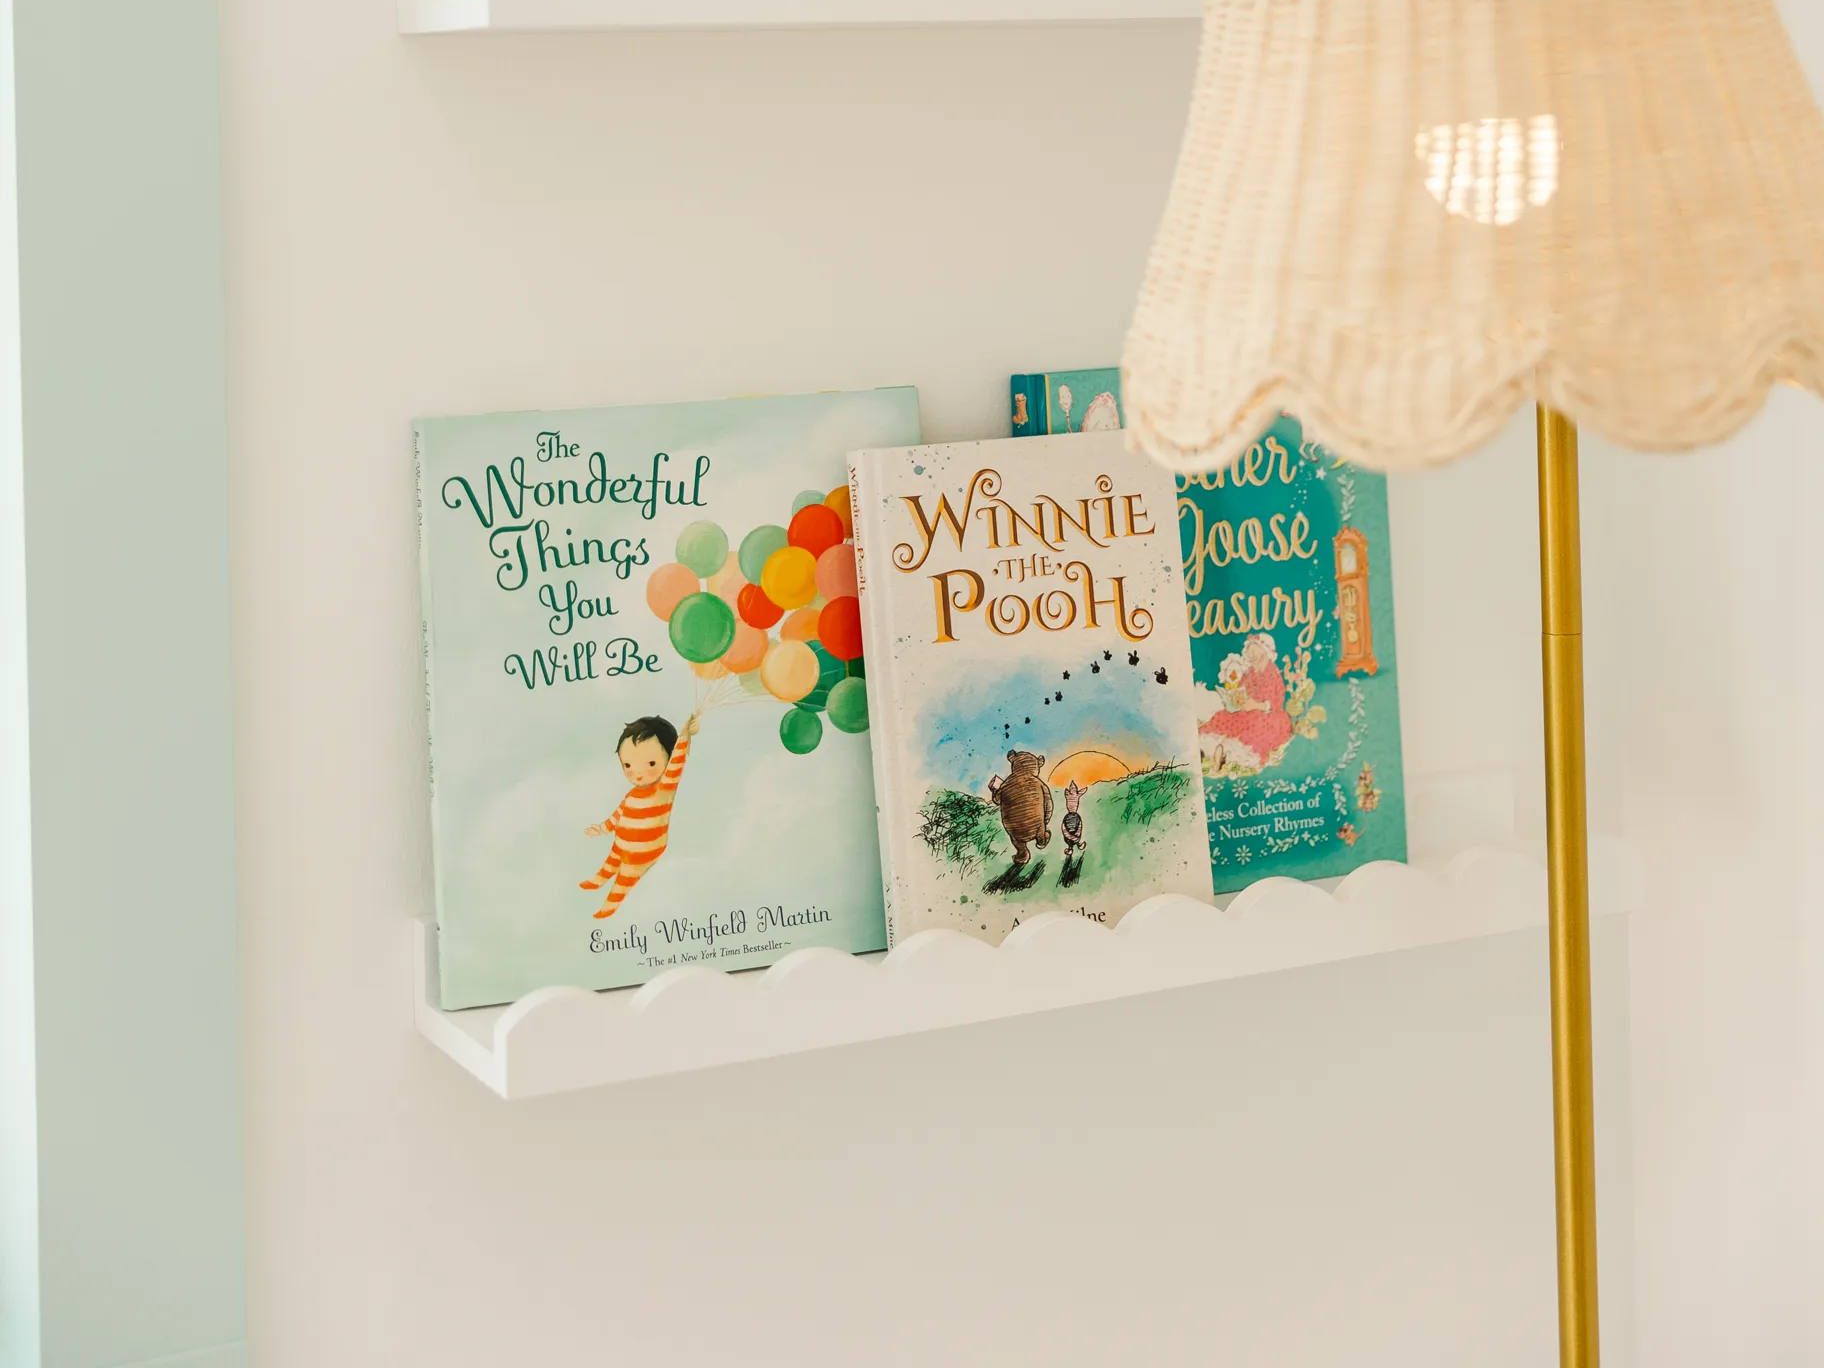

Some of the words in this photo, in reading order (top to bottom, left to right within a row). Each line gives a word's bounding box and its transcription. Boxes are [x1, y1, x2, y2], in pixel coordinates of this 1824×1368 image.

[536, 430, 581, 463] The
[441, 451, 711, 529] Wonderful
[489, 518, 650, 592] Things
[996, 552, 1056, 583] THE
[538, 579, 620, 636] You
[926, 560, 1155, 643] POOH
[1187, 586, 1324, 648] easury
[504, 640, 600, 690] Will
[605, 637, 664, 677] Be
[1206, 806, 1235, 823] eless
[1237, 797, 1305, 818] Collection
[1306, 791, 1323, 808] of
[1219, 823, 1271, 840] Nursery
[1273, 815, 1325, 838] Rhymes
[589, 923, 648, 955] Emily
[654, 909, 748, 945] Winfield
[756, 905, 833, 933] Martin
[646, 956, 665, 968] The
[667, 953, 677, 964] #1
[680, 951, 698, 963] New
[700, 947, 717, 959] York
[720, 944, 742, 957] Times
[743, 940, 783, 954] Bestseller
